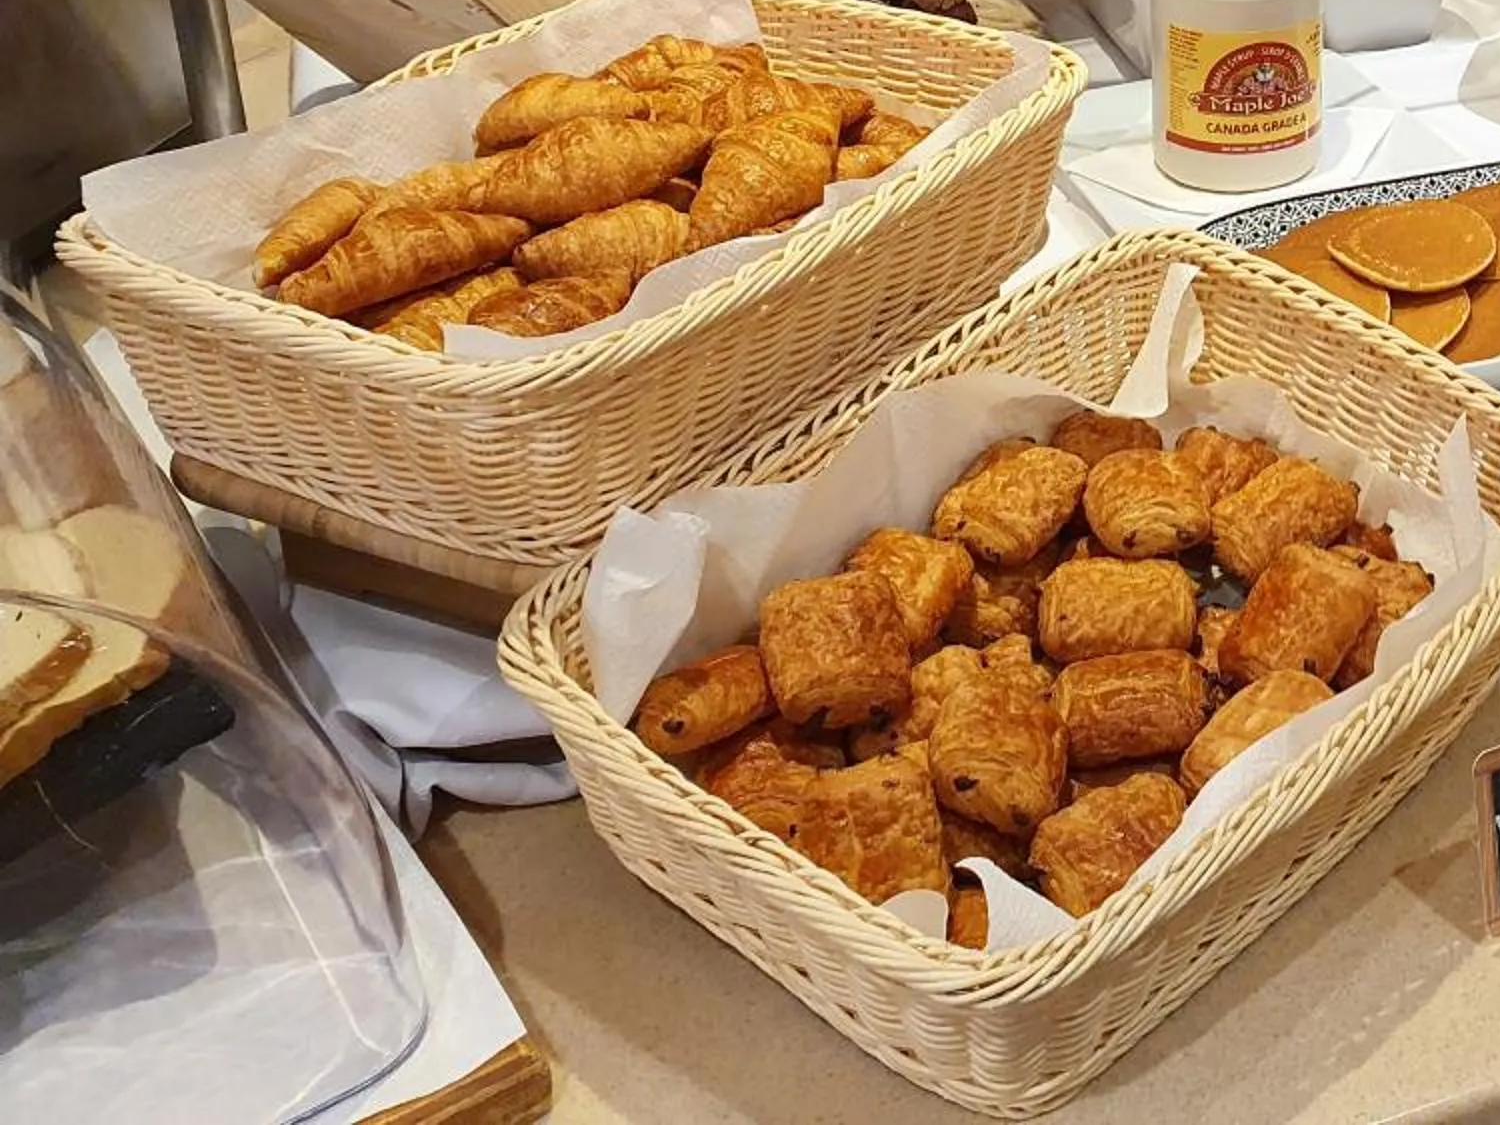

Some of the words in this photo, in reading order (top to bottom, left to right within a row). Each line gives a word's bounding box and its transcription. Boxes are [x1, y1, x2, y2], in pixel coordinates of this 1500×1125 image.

[1209, 95, 1275, 116] Maple
[1205, 122, 1260, 135] CANADA
[1262, 114, 1299, 132] GRADE
